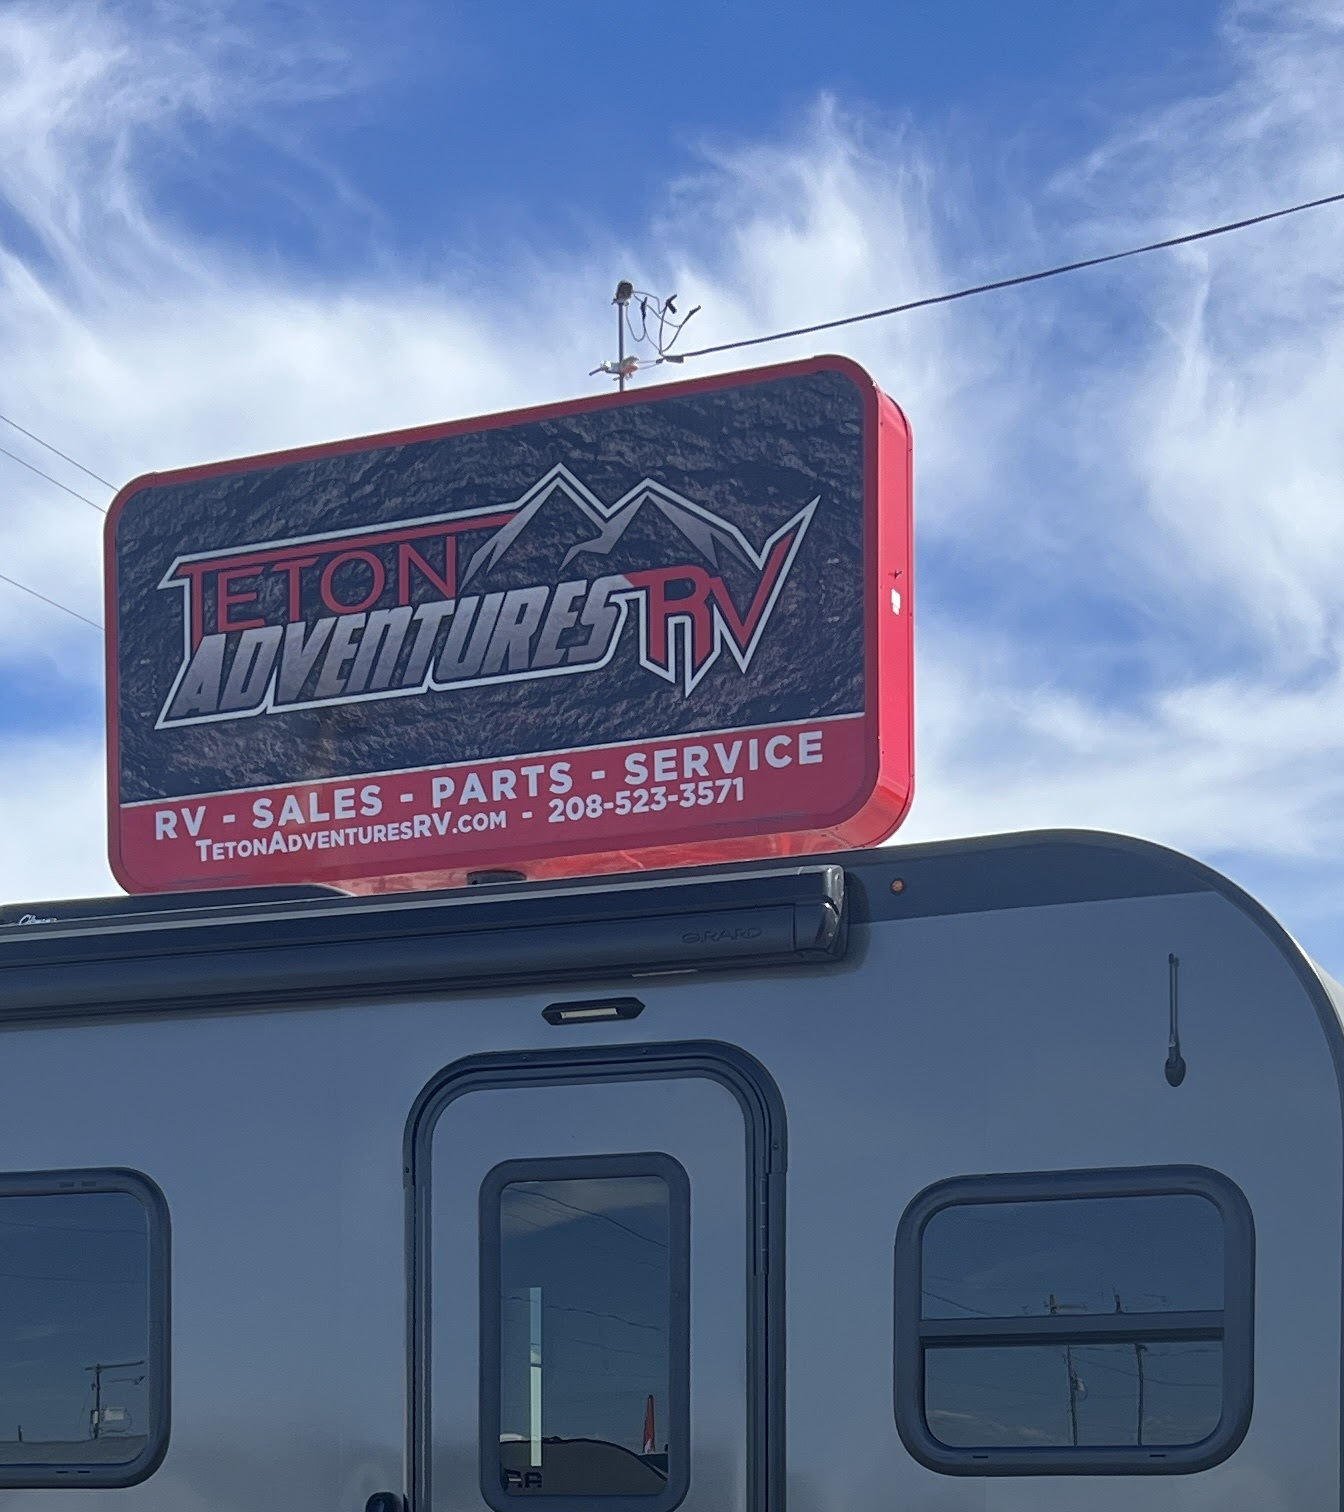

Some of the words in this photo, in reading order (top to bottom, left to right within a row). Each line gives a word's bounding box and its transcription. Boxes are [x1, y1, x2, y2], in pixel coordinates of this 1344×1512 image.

[168, 573, 634, 718] ADVENTURES
[626, 530, 799, 669] RV
[176, 534, 456, 653] TETON
[155, 806, 206, 840] RV
[252, 785, 383, 829] SALES
[432, 762, 573, 809] PARTS
[624, 730, 823, 785] SERVICE
[548, 776, 744, 823] 208-523-3571
